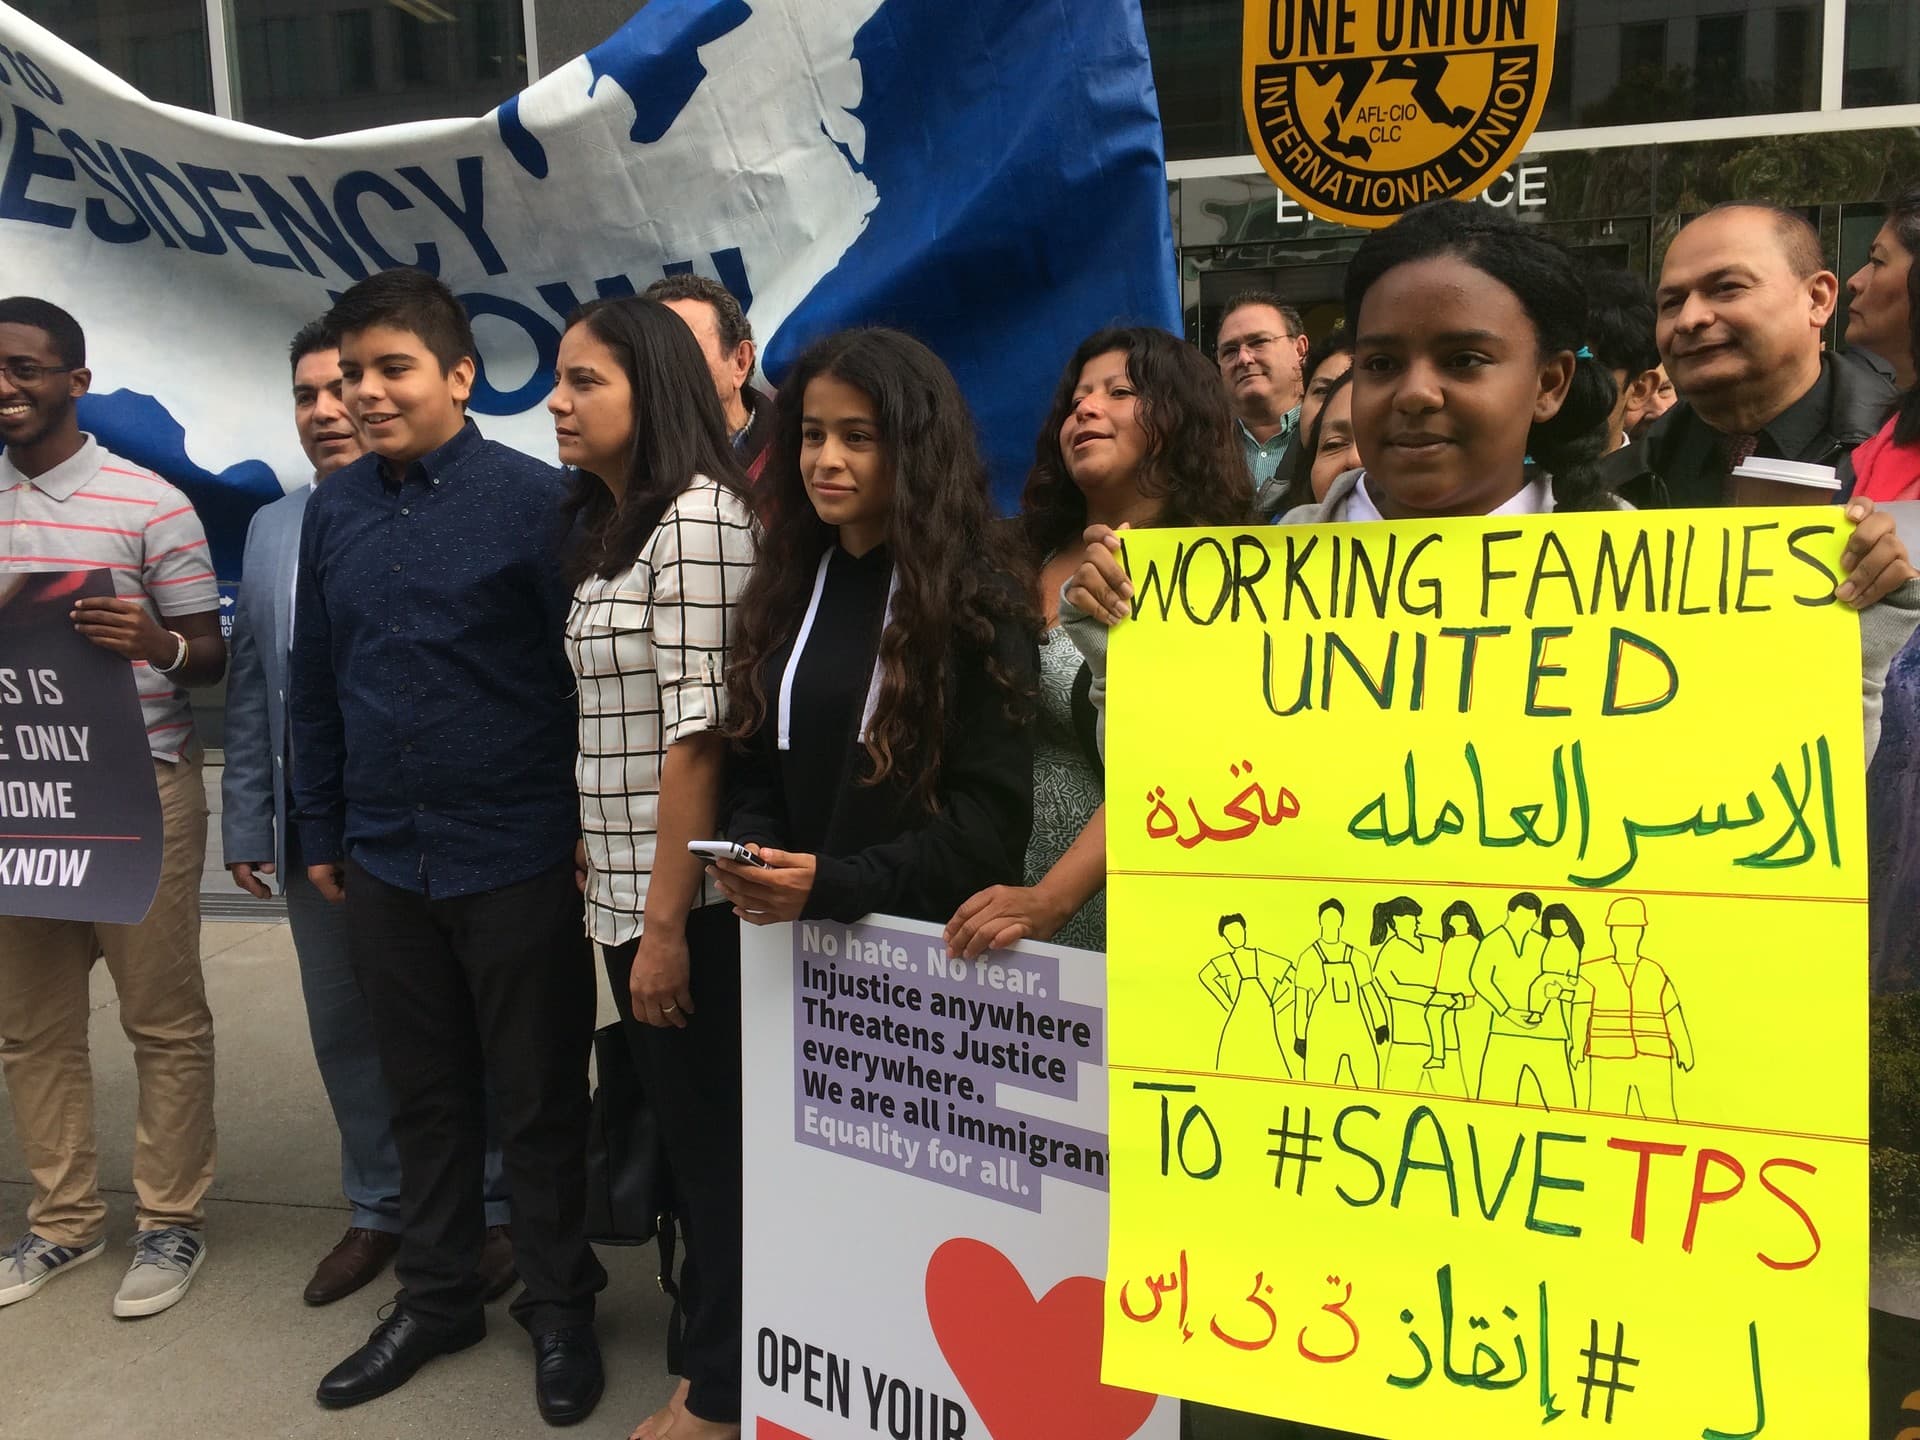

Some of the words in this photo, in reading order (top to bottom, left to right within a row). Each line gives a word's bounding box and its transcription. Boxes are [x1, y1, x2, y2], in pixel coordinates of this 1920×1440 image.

[1268, 0, 1356, 60] ONE
[1376, 0, 1527, 52] UNION
[1260, 75, 1462, 209] INTERNATIONAL
[1458, 55, 1531, 170] UNION
[1356, 103, 1418, 124] AFL-CIO
[1368, 125, 1402, 143] CLC
[0, 104, 508, 281] ESIDENCY
[1120, 533, 1444, 625] WORKING
[1481, 523, 1840, 615] FAMILIES
[27, 669, 64, 705] IS
[1263, 626, 1678, 716] UNITED
[15, 725, 90, 762] ONLY
[802, 924, 838, 953] No
[845, 930, 918, 973] hate.
[927, 946, 968, 982] No
[975, 955, 1048, 998] fear.
[803, 961, 922, 1012] Injustice
[930, 992, 1091, 1048] anywhere
[802, 996, 945, 1055] Threatens
[953, 1031, 1066, 1083] Justice
[803, 1039, 985, 1104] everywhere.
[803, 1069, 843, 1104] We
[851, 1084, 895, 1119] are
[904, 1097, 940, 1131] all
[948, 1103, 1109, 1176] immigran
[804, 1105, 920, 1169] Equality
[928, 1138, 972, 1178] for
[980, 1159, 1029, 1196] all.
[1133, 1082, 1222, 1180] TO
[757, 1326, 850, 1420] OPEN
